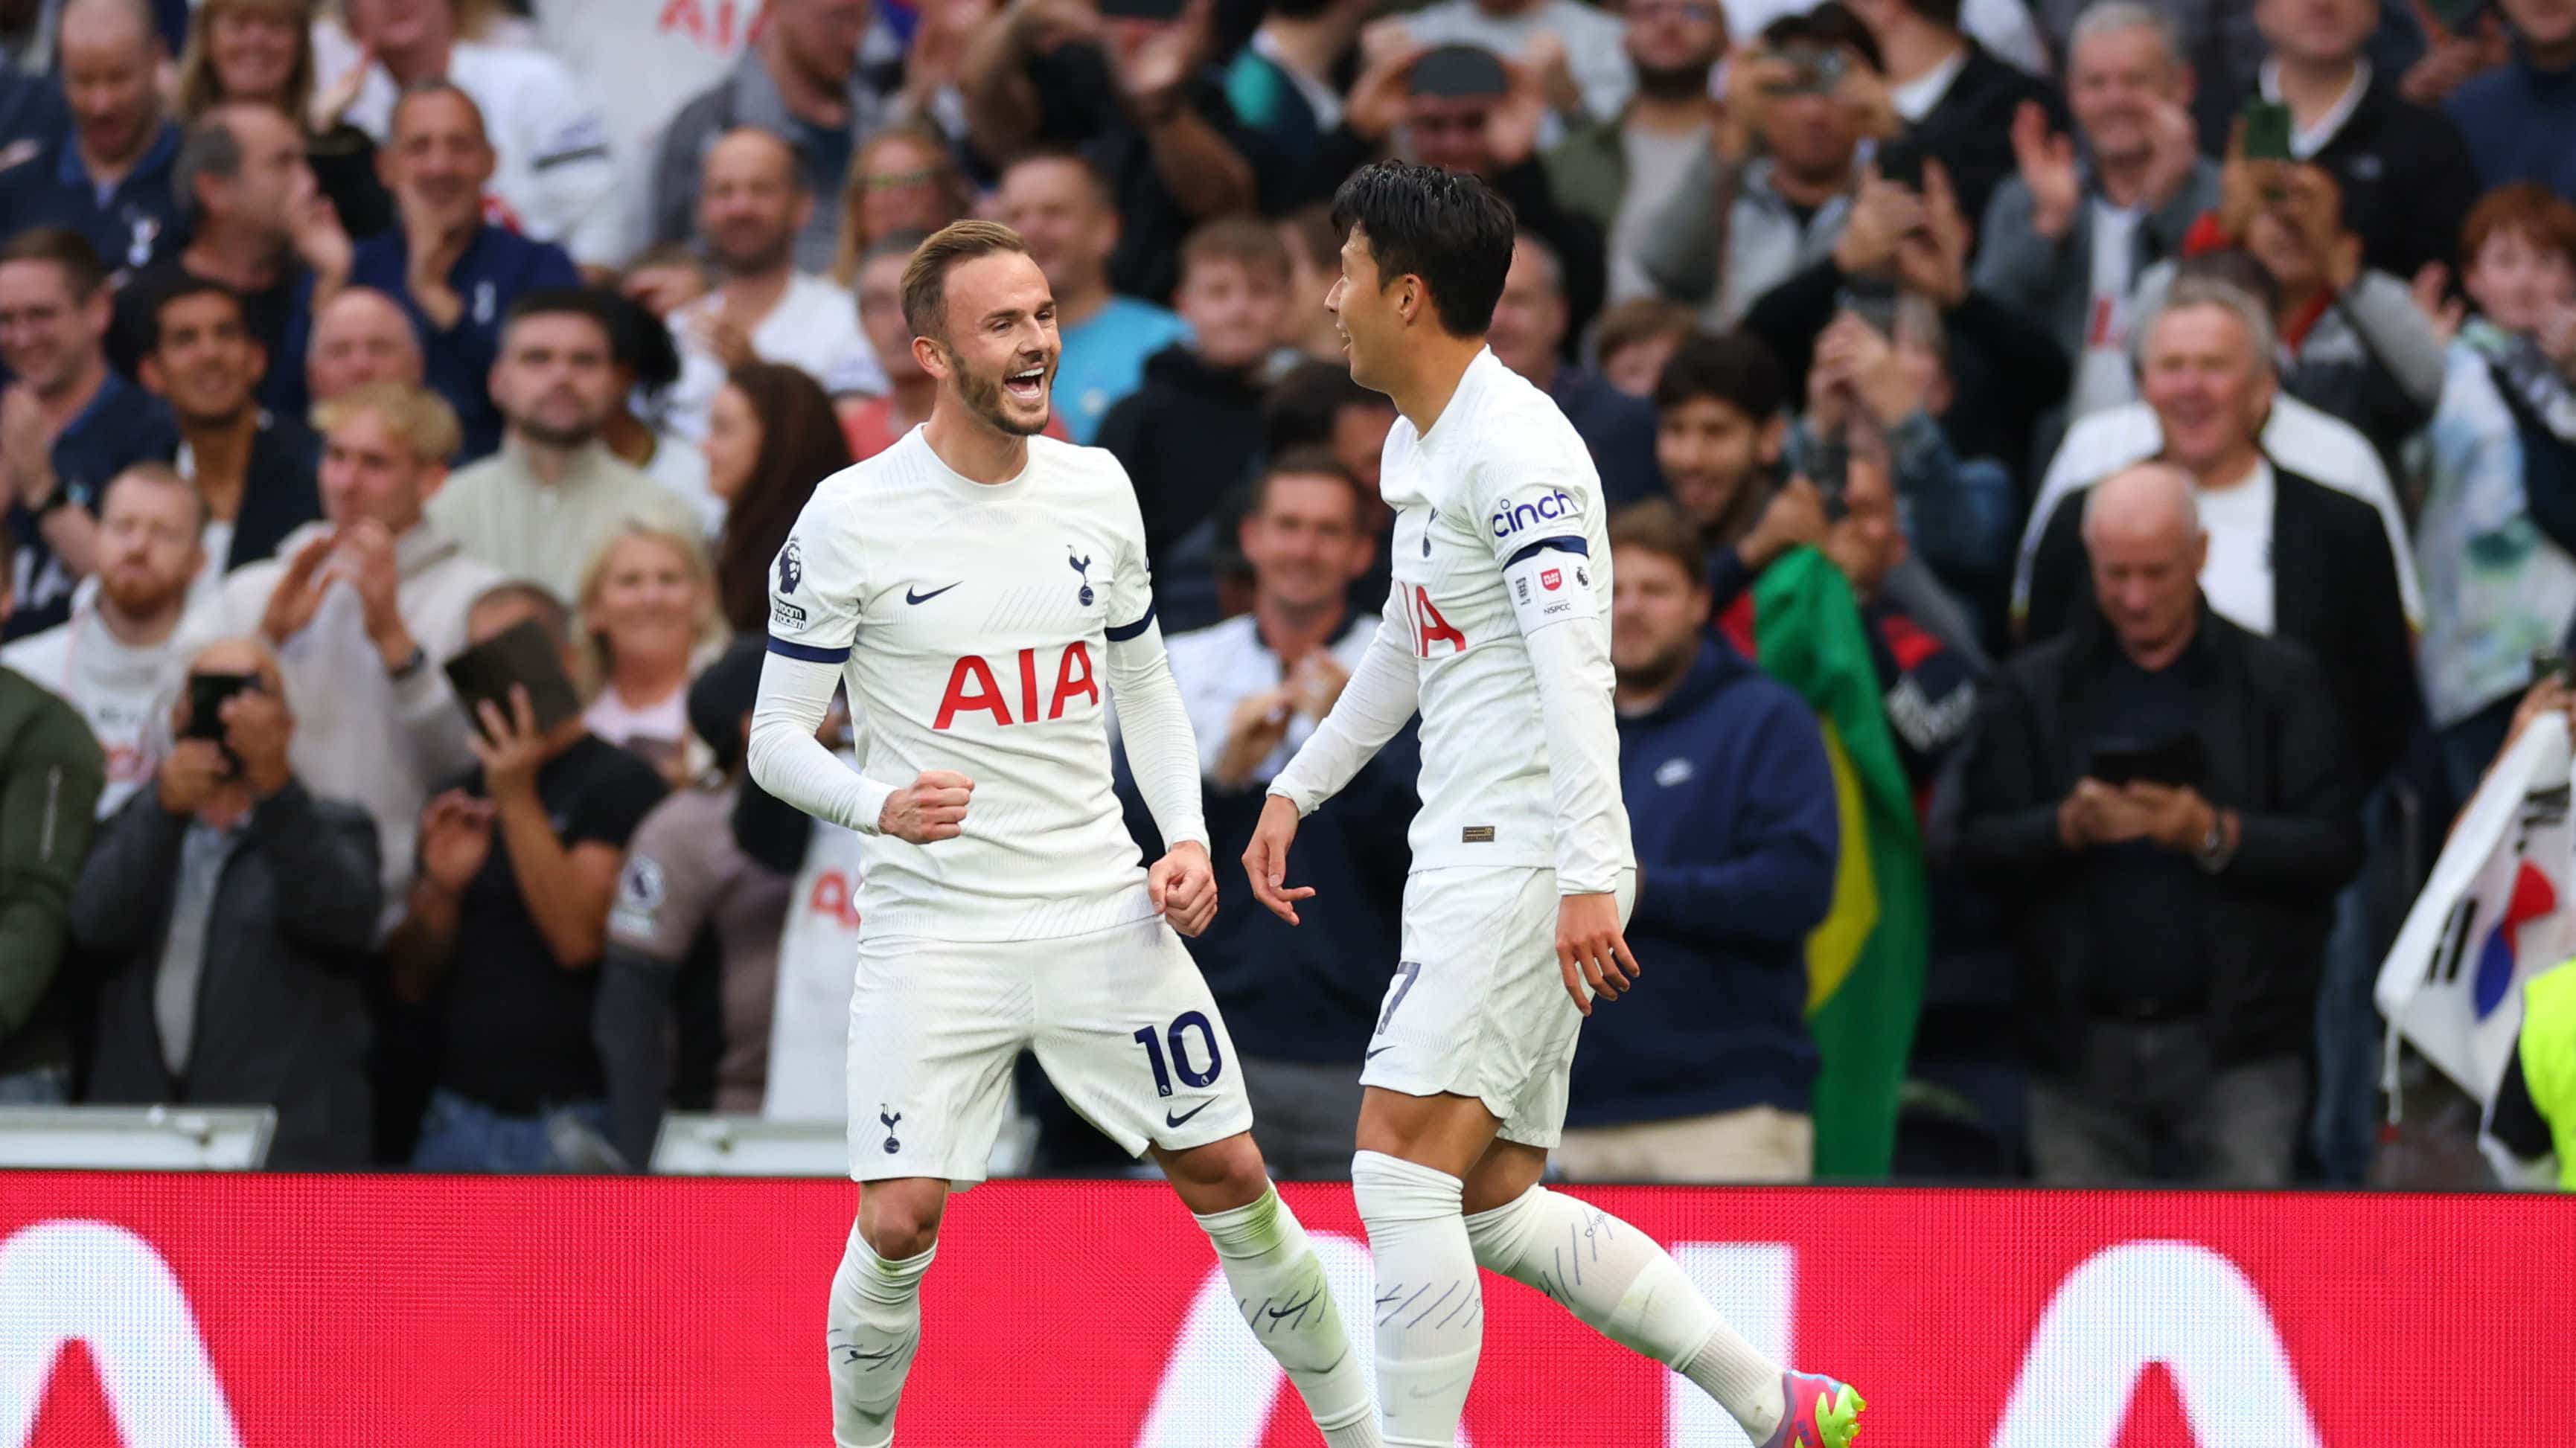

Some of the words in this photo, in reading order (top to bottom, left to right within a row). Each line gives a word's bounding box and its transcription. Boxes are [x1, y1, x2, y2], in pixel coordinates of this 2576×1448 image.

[1492, 488, 1579, 537] cinch
[1544, 603, 1571, 614] NSPCC
[933, 640, 1099, 729] AIA
[1376, 961, 1422, 1035] 7
[1134, 1010, 1221, 1098] 10
